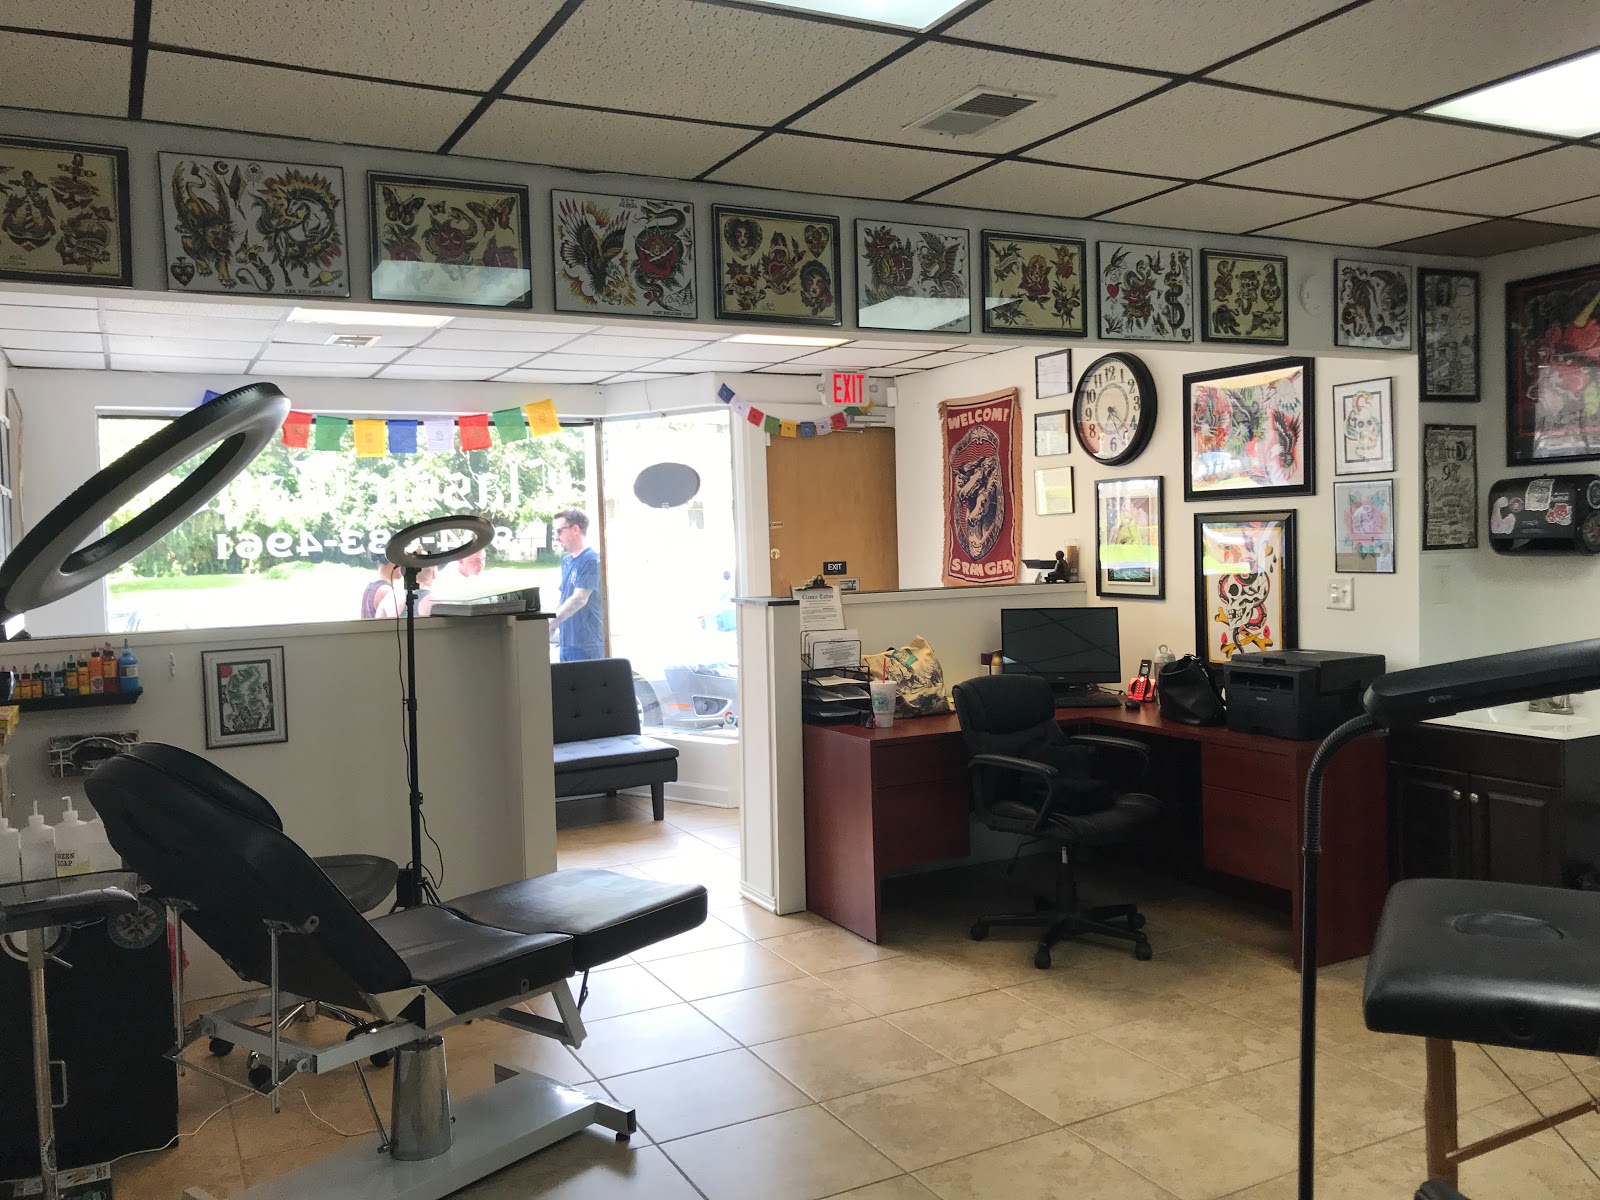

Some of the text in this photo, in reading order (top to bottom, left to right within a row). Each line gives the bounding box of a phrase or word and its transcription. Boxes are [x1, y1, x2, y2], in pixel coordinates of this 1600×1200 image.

[1094, 373, 1102, 388] 11
[1104, 365, 1115, 381] 12
[833, 374, 864, 403] EXIT
[1127, 378, 1136, 394] 2
[1086, 389, 1096, 404] 10
[1133, 395, 1140, 411] 3
[1085, 407, 1092, 421] 9
[1130, 415, 1138, 430] 4
[1089, 423, 1096, 438] 8
[1110, 437, 1117, 452] 6
[828, 563, 842, 571] EXIT
